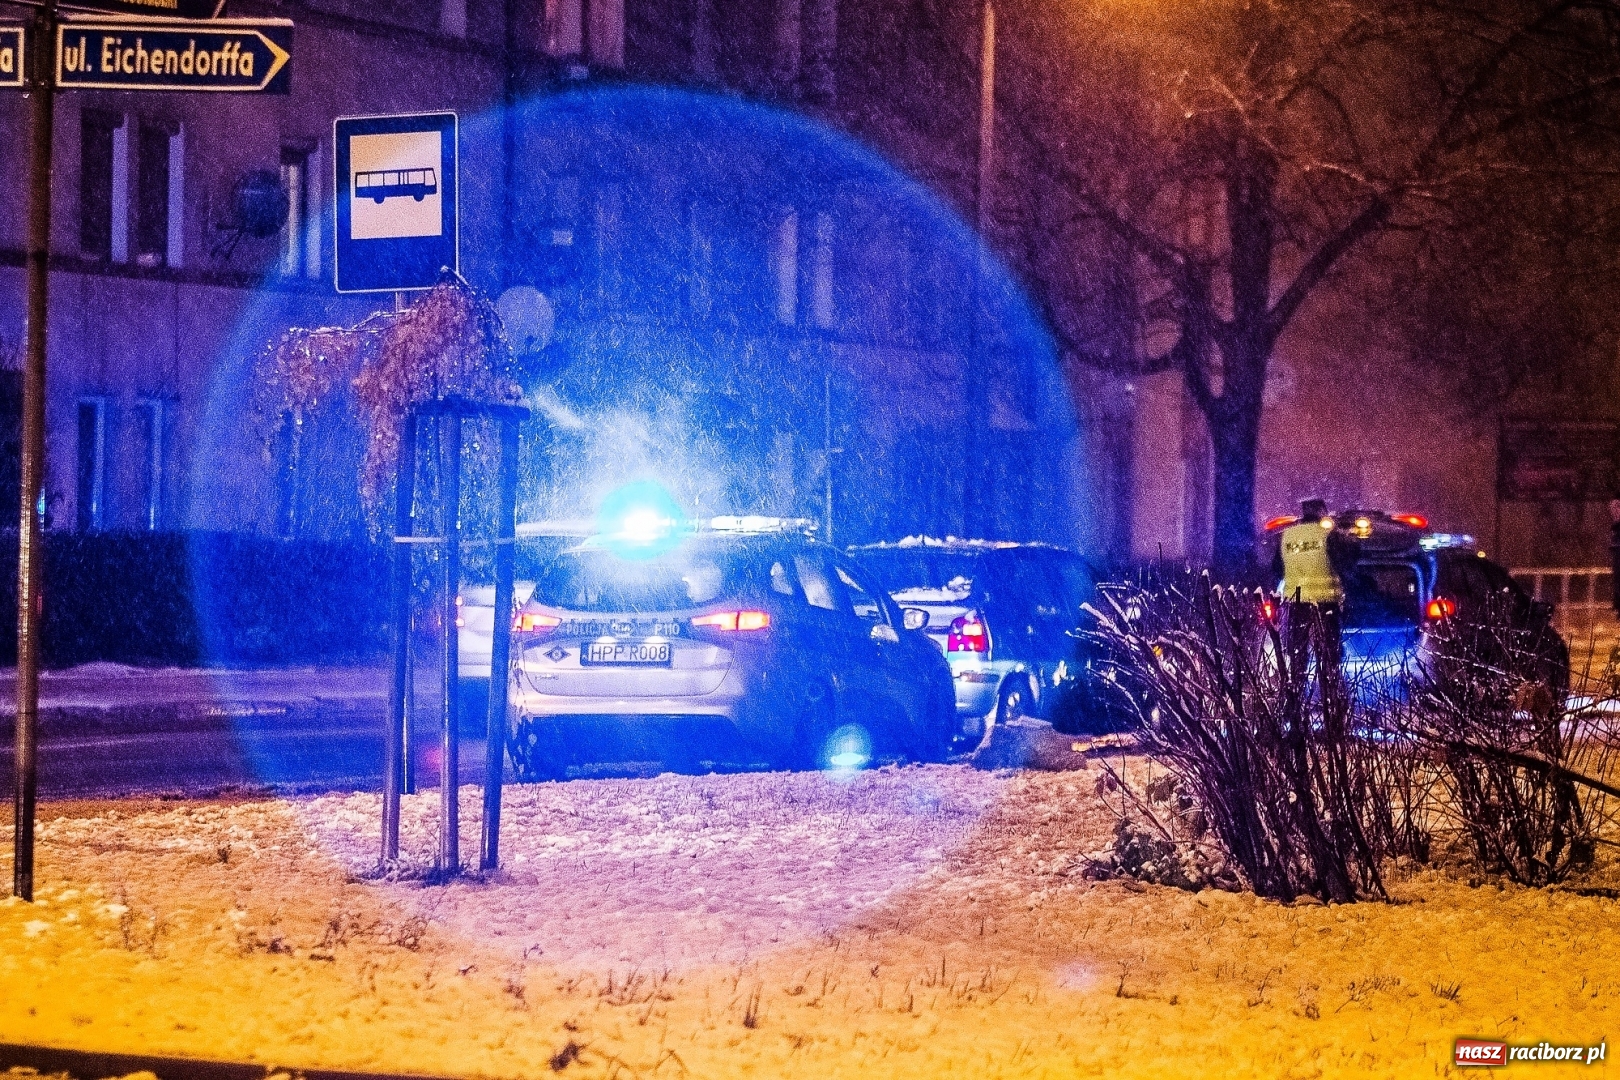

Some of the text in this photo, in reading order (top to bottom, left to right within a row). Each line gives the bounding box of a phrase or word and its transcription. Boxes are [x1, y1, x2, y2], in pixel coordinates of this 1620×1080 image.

[0, 46, 13, 73] a
[64, 36, 254, 77] ul. Eichendorffa
[654, 623, 680, 636] P110
[590, 645, 668, 661] HPP R008
